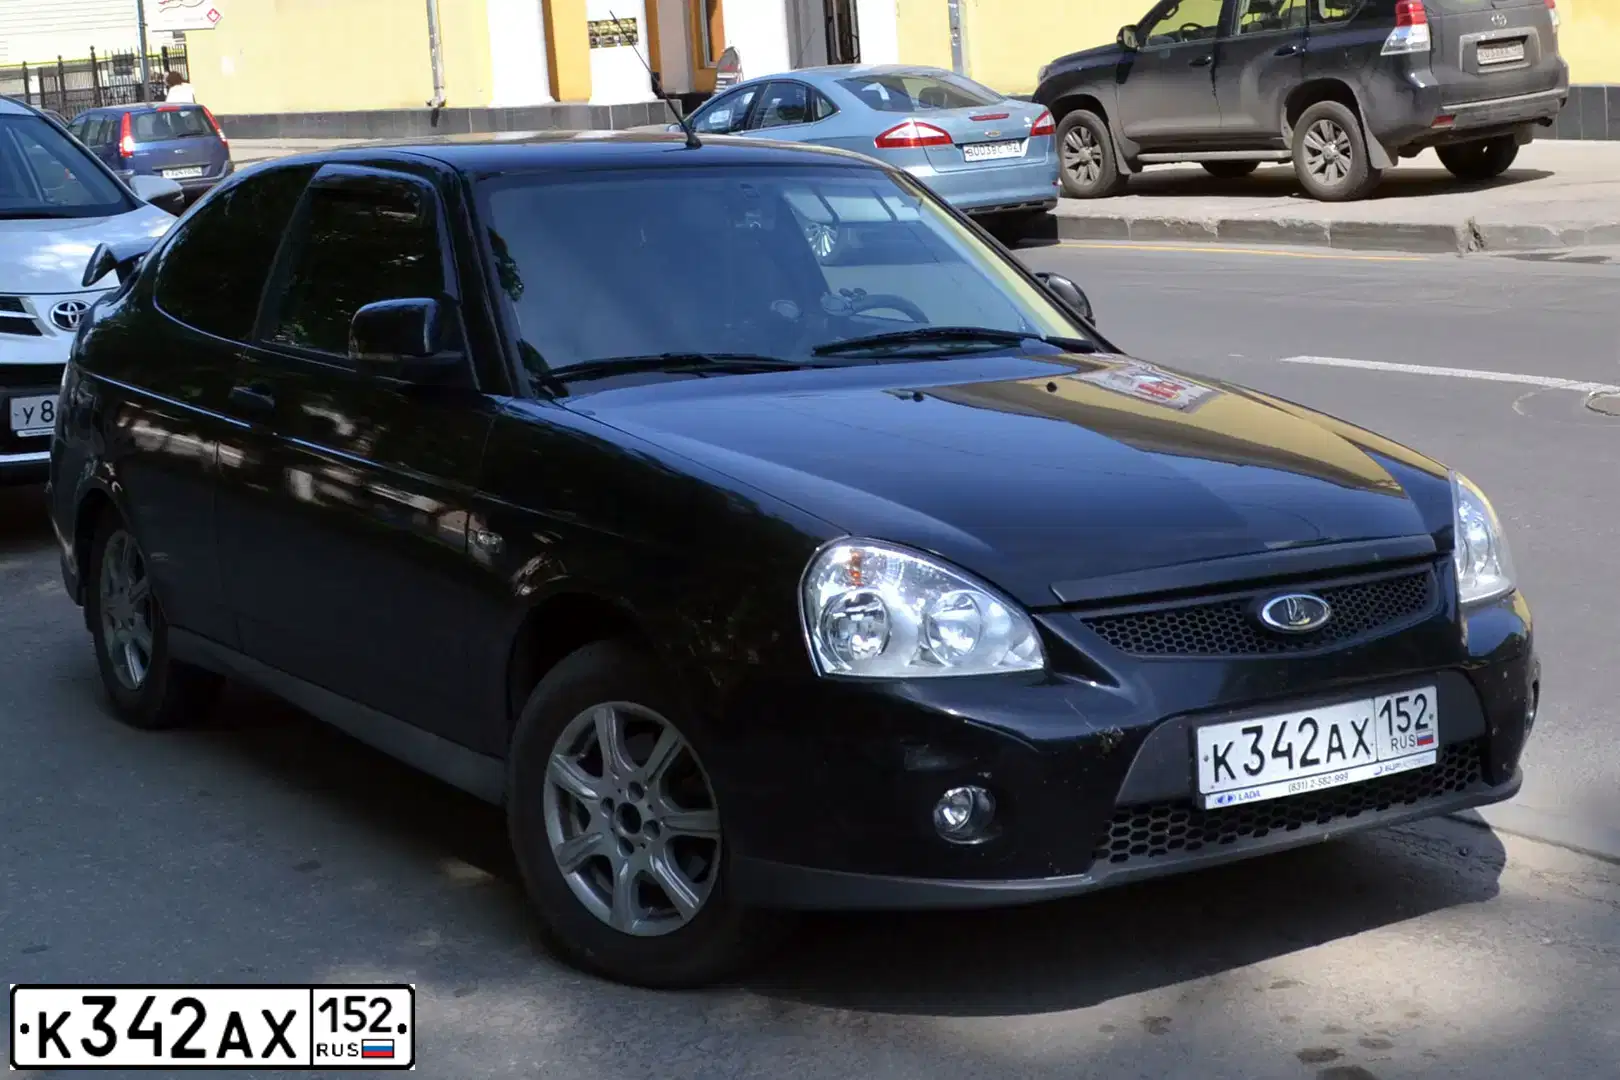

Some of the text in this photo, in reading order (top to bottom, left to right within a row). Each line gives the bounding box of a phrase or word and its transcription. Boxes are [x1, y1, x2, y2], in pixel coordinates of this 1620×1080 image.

[1212, 693, 1429, 783] К342АХ 152
[1391, 734, 1416, 751] RUS
[1238, 790, 1261, 801] LADA
